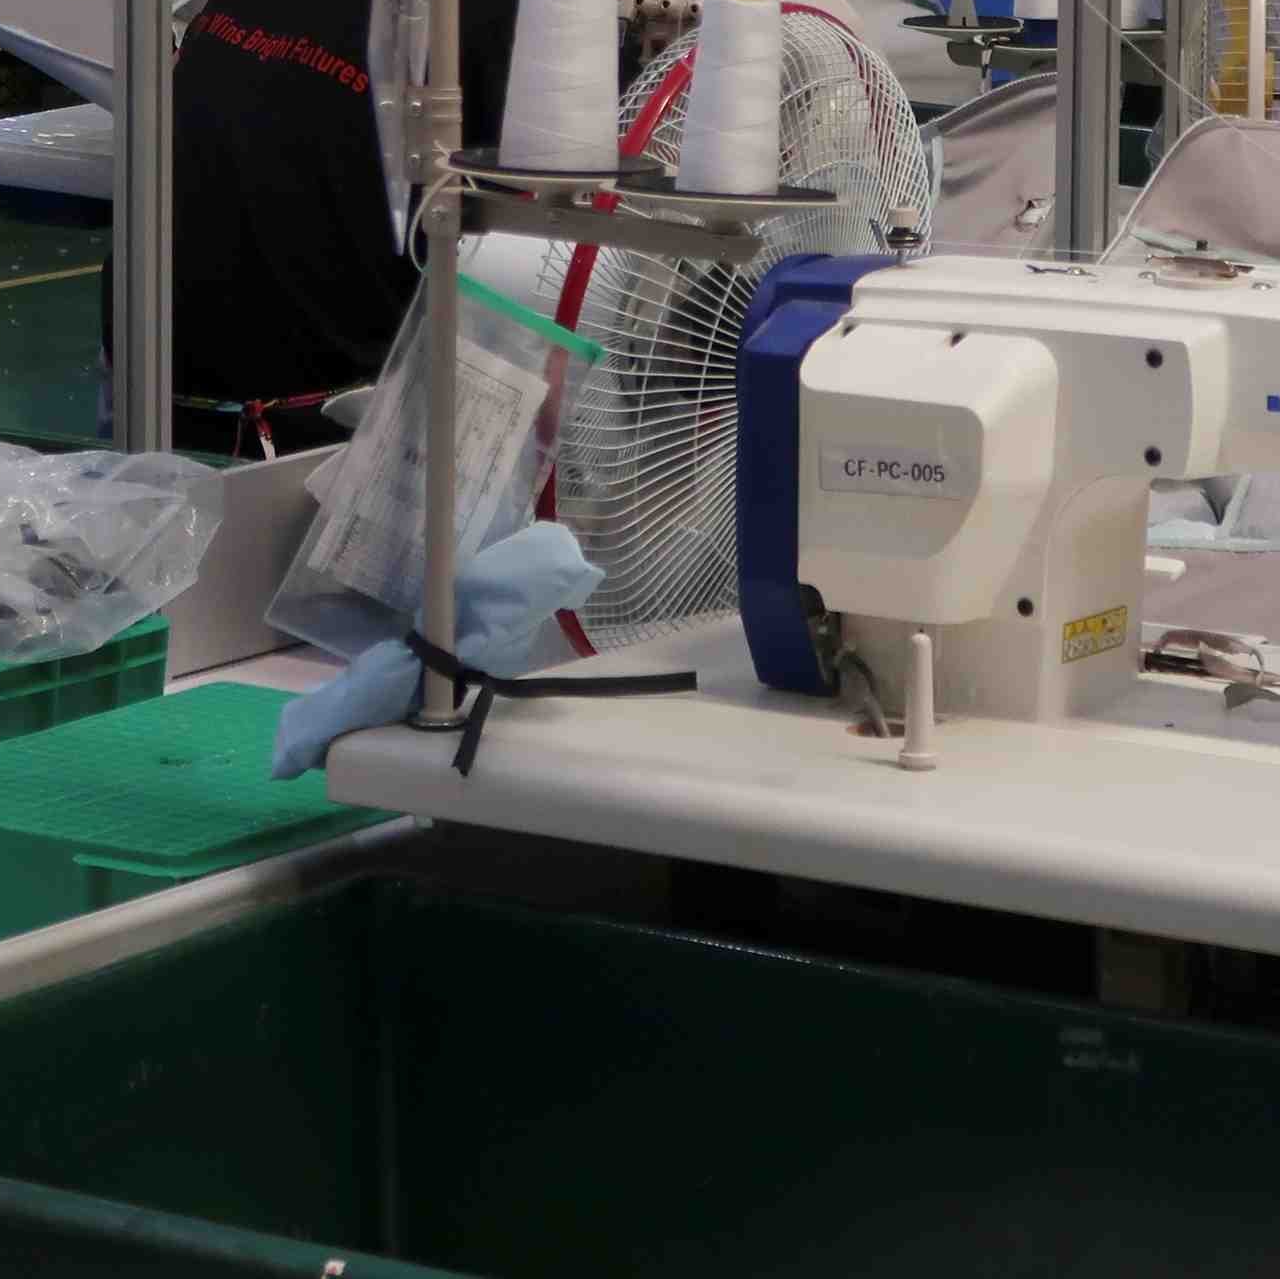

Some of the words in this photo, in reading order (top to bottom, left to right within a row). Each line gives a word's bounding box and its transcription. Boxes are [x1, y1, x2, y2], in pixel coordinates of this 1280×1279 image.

[208, 13, 246, 45] Wins
[241, 28, 294, 63] Bright
[293, 36, 369, 95] Futures
[844, 459, 945, 482] CF-PC-005
